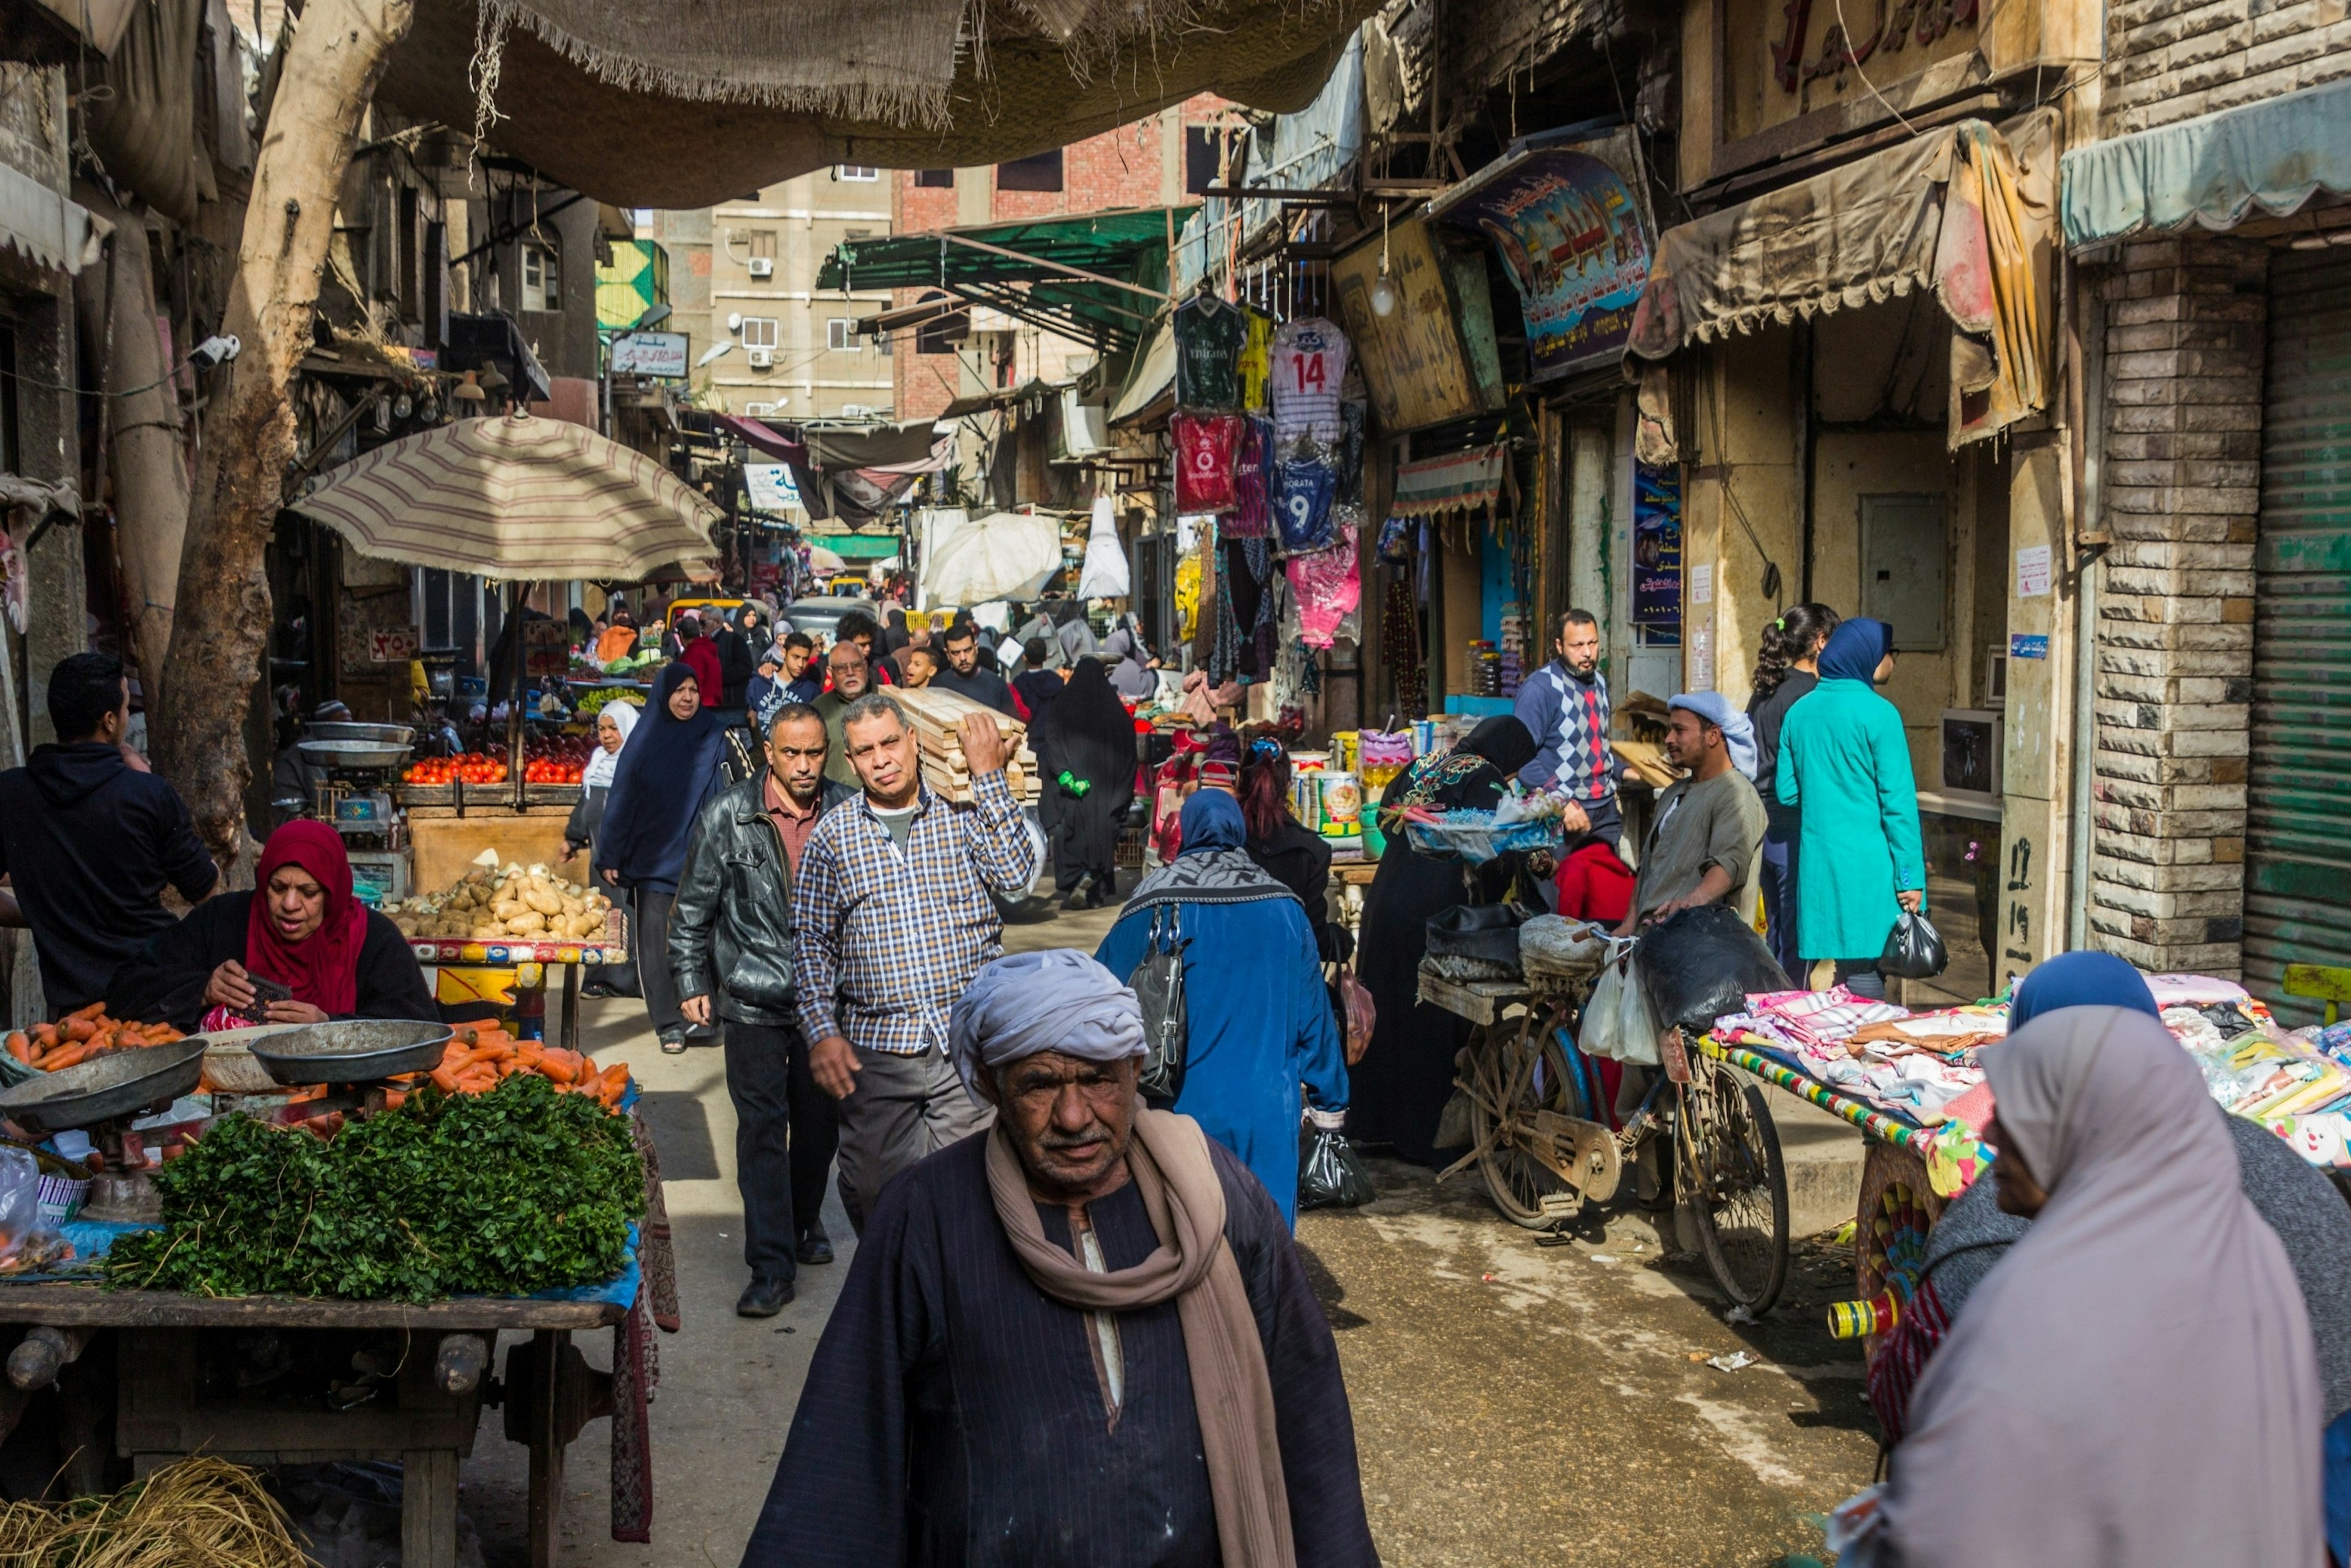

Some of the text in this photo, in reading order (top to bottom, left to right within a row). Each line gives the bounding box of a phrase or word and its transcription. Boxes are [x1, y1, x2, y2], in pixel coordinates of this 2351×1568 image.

[1292, 353, 1325, 393] 14
[1289, 495, 1310, 528] 9
[2011, 640, 2047, 655] توكلت على الله
